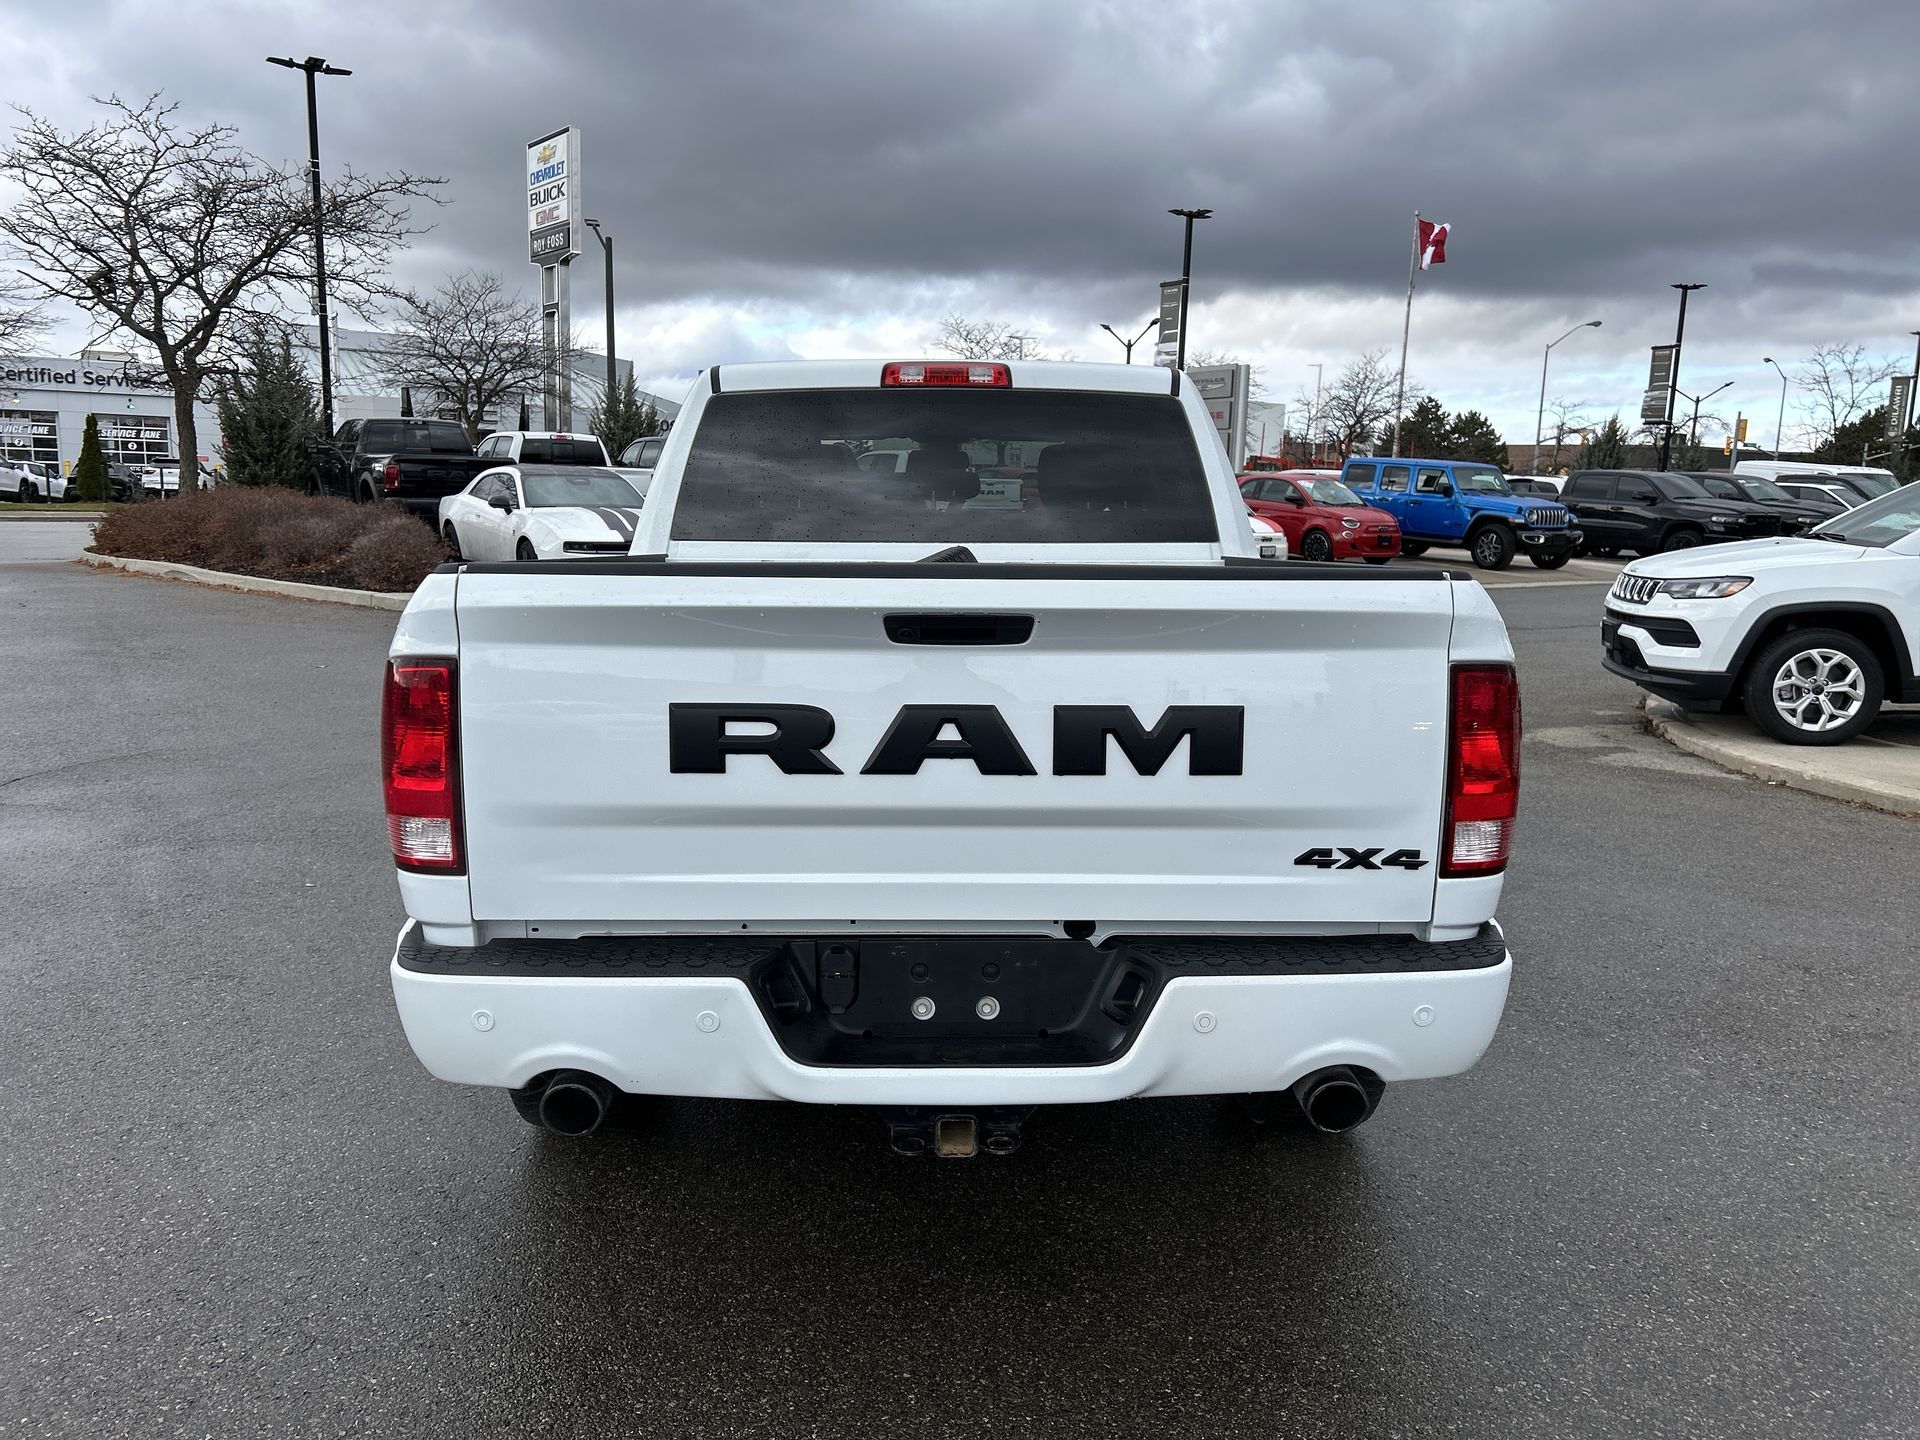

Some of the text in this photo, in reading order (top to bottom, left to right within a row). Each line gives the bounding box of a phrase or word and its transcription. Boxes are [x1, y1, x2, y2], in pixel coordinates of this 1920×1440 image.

[530, 160, 565, 186] CHEVROLET
[530, 181, 566, 207] BUICK
[535, 205, 560, 226] GMC
[533, 232, 564, 252] ROY FOSS
[83, 370, 149, 389] Servic
[27, 426, 49, 434] LANE
[100, 428, 161, 439] SERVICE LANE
[669, 702, 1245, 776] RAM
[1294, 847, 1429, 871] 4X4
